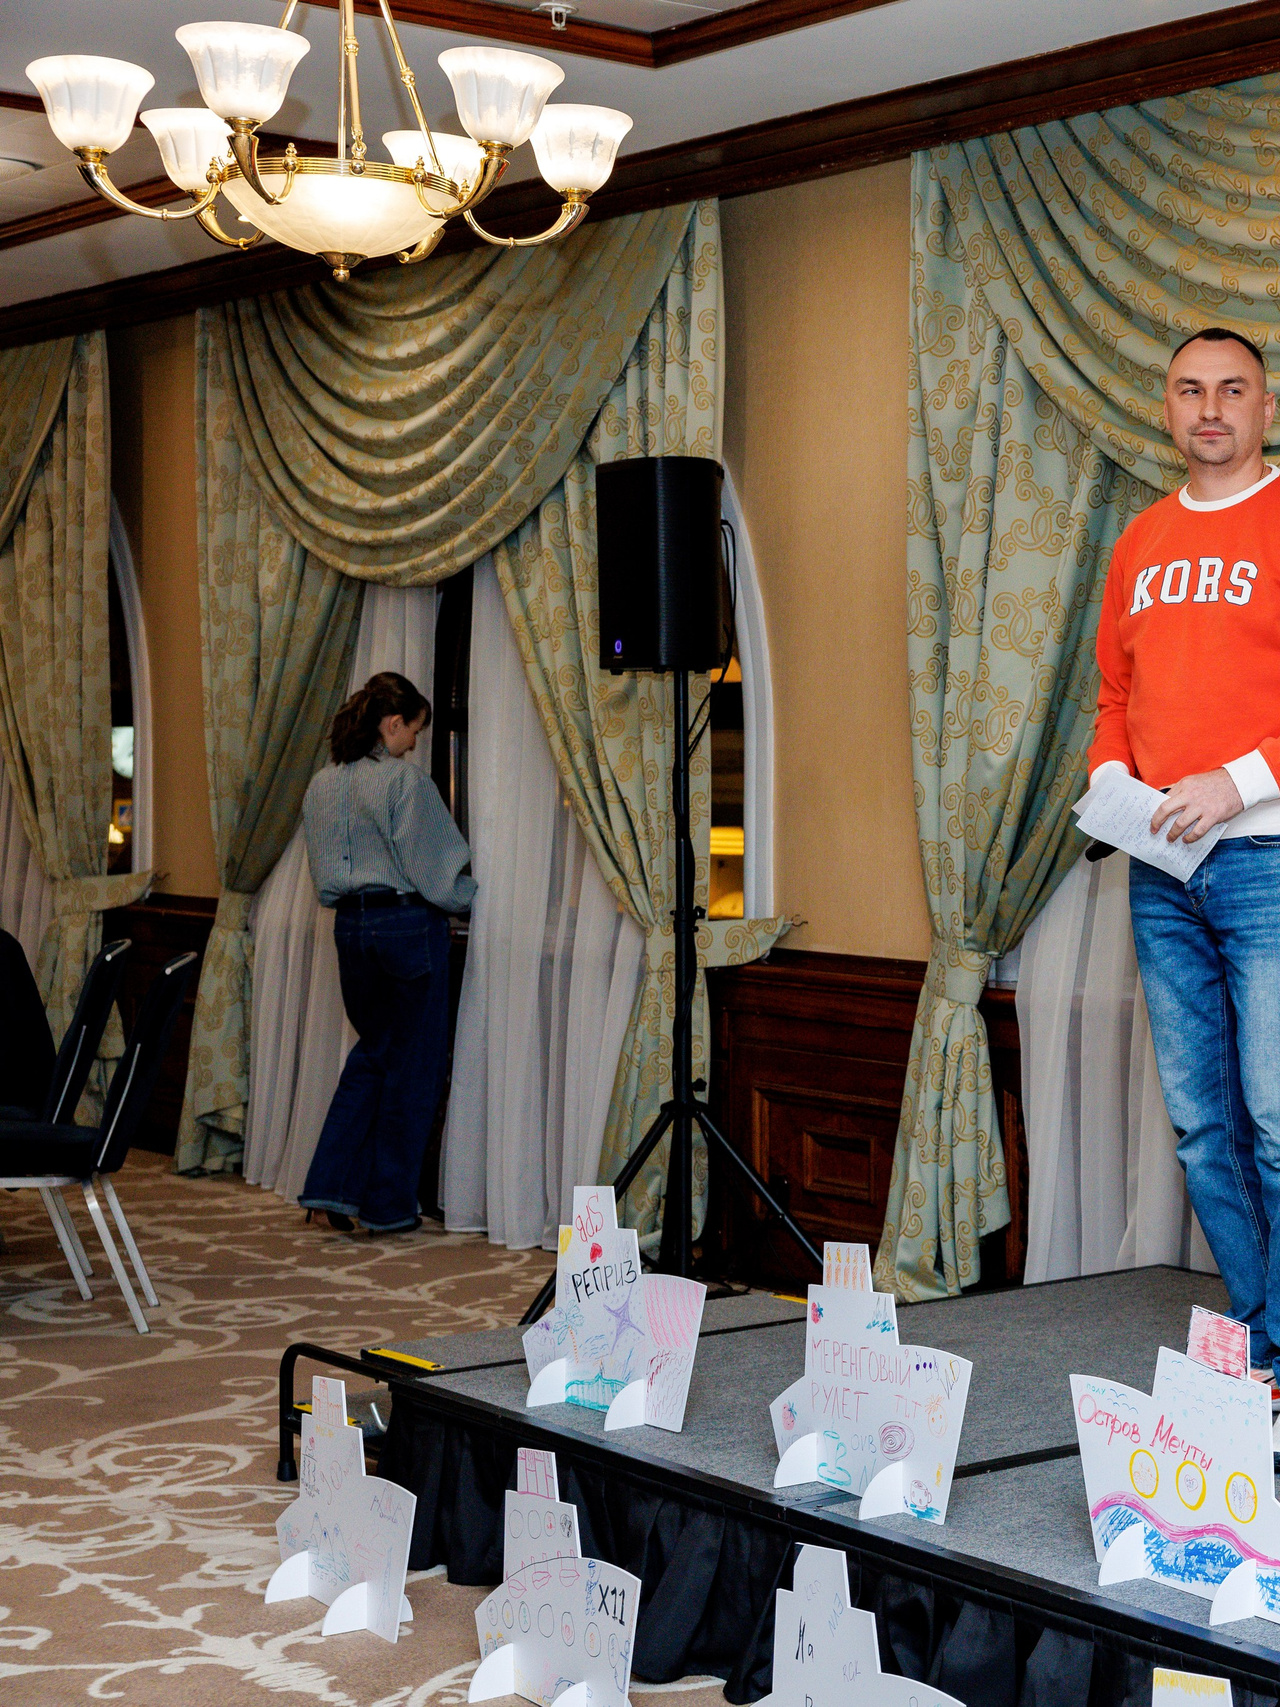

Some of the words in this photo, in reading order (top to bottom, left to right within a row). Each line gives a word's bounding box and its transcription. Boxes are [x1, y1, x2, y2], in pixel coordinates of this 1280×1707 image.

[1129, 556, 1259, 616] KORS
[571, 1259, 637, 1303] РЕПРИЗ
[811, 1337, 912, 1388] МЕРЕНГОВЫЙ
[811, 1381, 870, 1422] РУЛЕТ
[1078, 1393, 1141, 1446] Остров
[1149, 1414, 1213, 1471] Мечты
